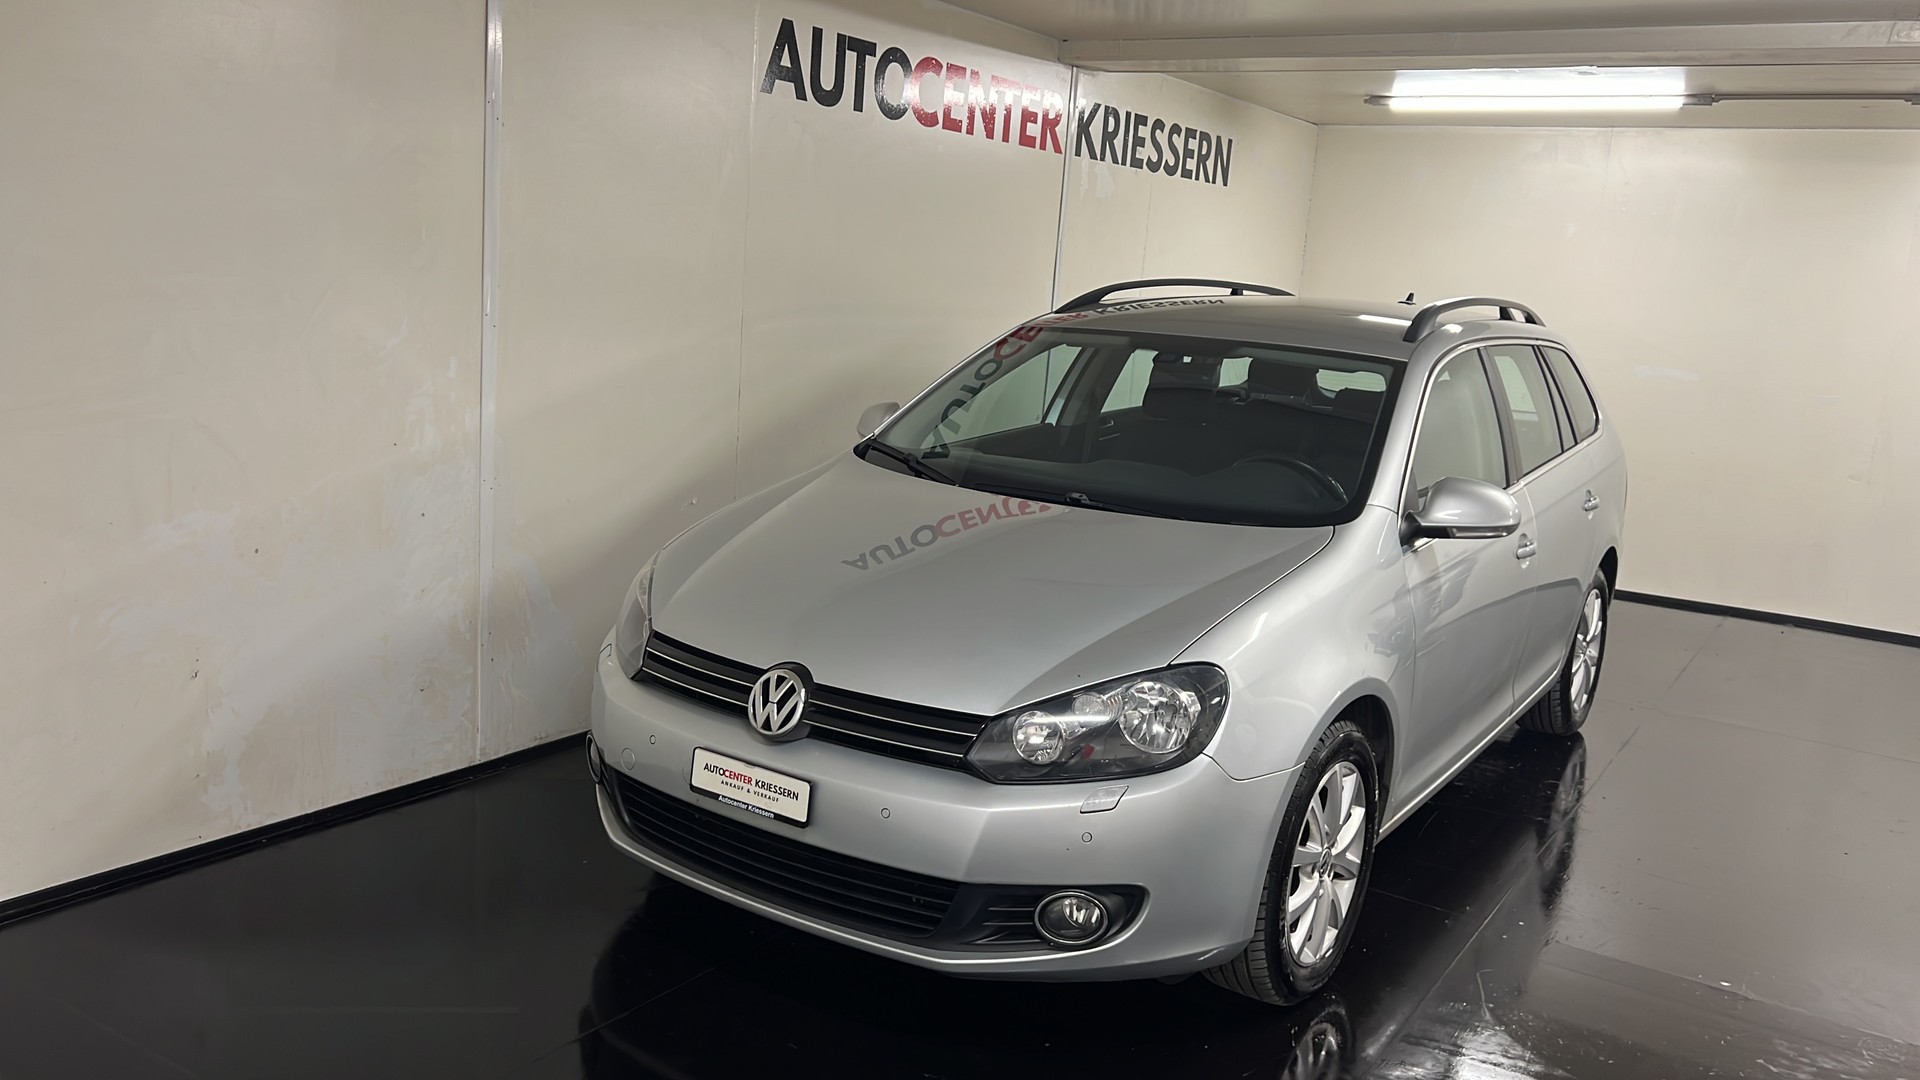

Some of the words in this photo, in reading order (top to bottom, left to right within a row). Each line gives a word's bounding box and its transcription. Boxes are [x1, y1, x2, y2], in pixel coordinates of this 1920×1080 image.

[760, 18, 1063, 155] AUTOCENTER
[1074, 98, 1233, 187] KRIESSERN
[703, 762, 753, 786] AUTOCENTER
[754, 778, 799, 802] KRIESSERN
[720, 780, 744, 791] ANKAUF
[753, 790, 779, 803] VERKAUF
[718, 795, 748, 811] Autocenter
[747, 804, 775, 819] Kriessern
